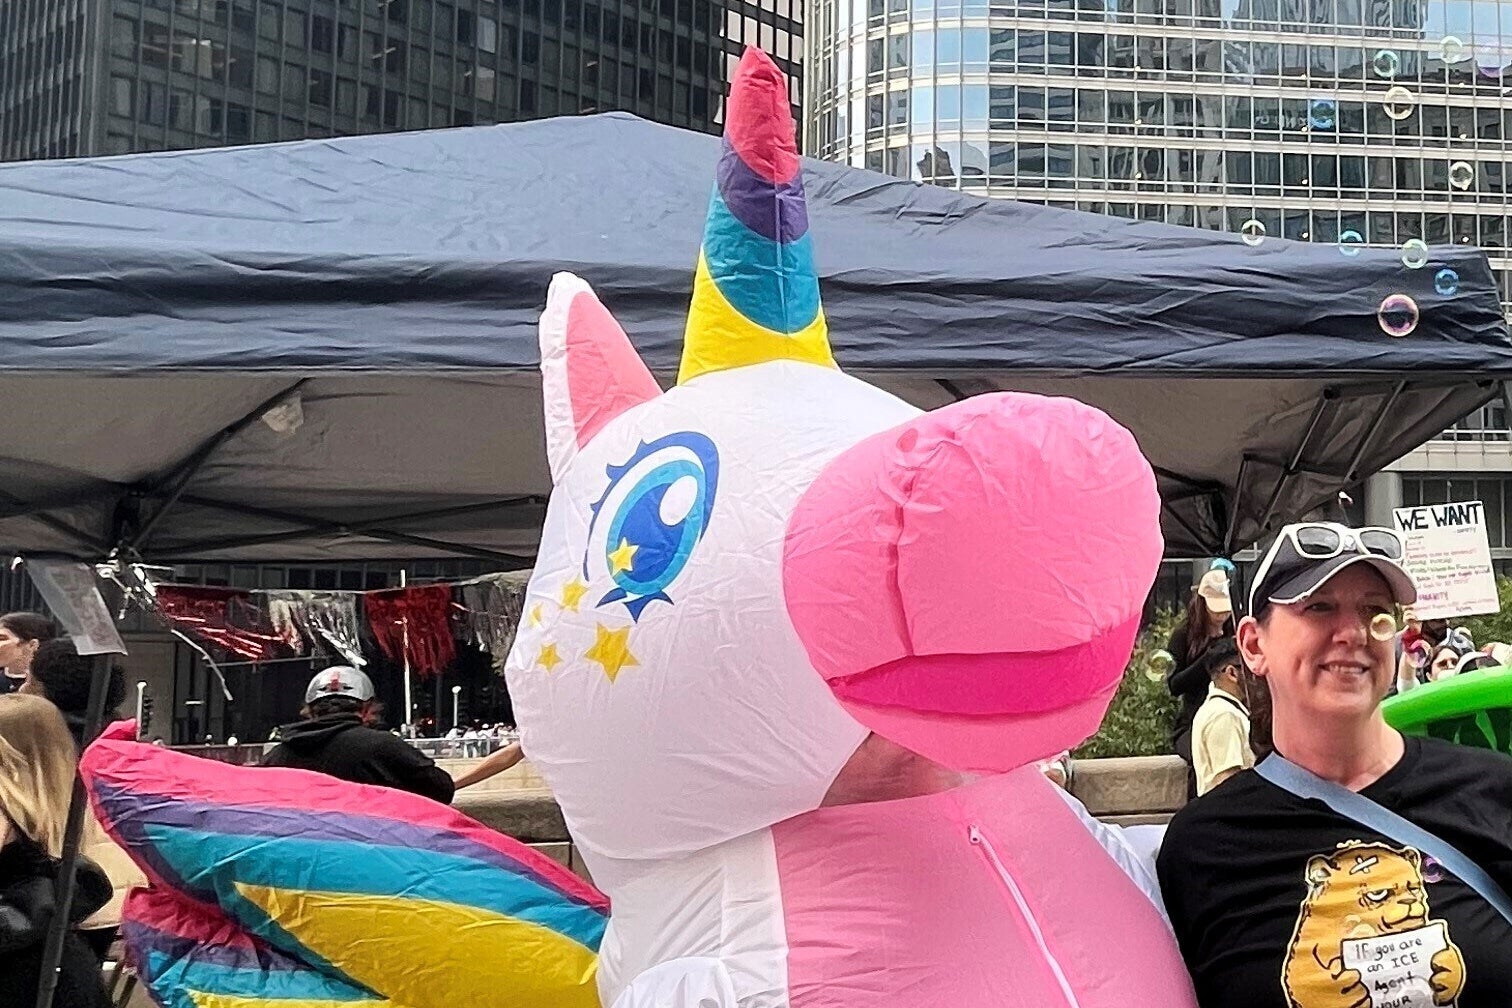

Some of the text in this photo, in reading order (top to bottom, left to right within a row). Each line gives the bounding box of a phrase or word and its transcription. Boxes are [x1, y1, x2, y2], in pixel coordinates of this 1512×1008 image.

[1395, 503, 1482, 531] WE WANT
[1374, 945, 1396, 961] you
[1399, 938, 1422, 950] are
[1367, 952, 1420, 973] an ICE
[1374, 970, 1415, 995] Agent
